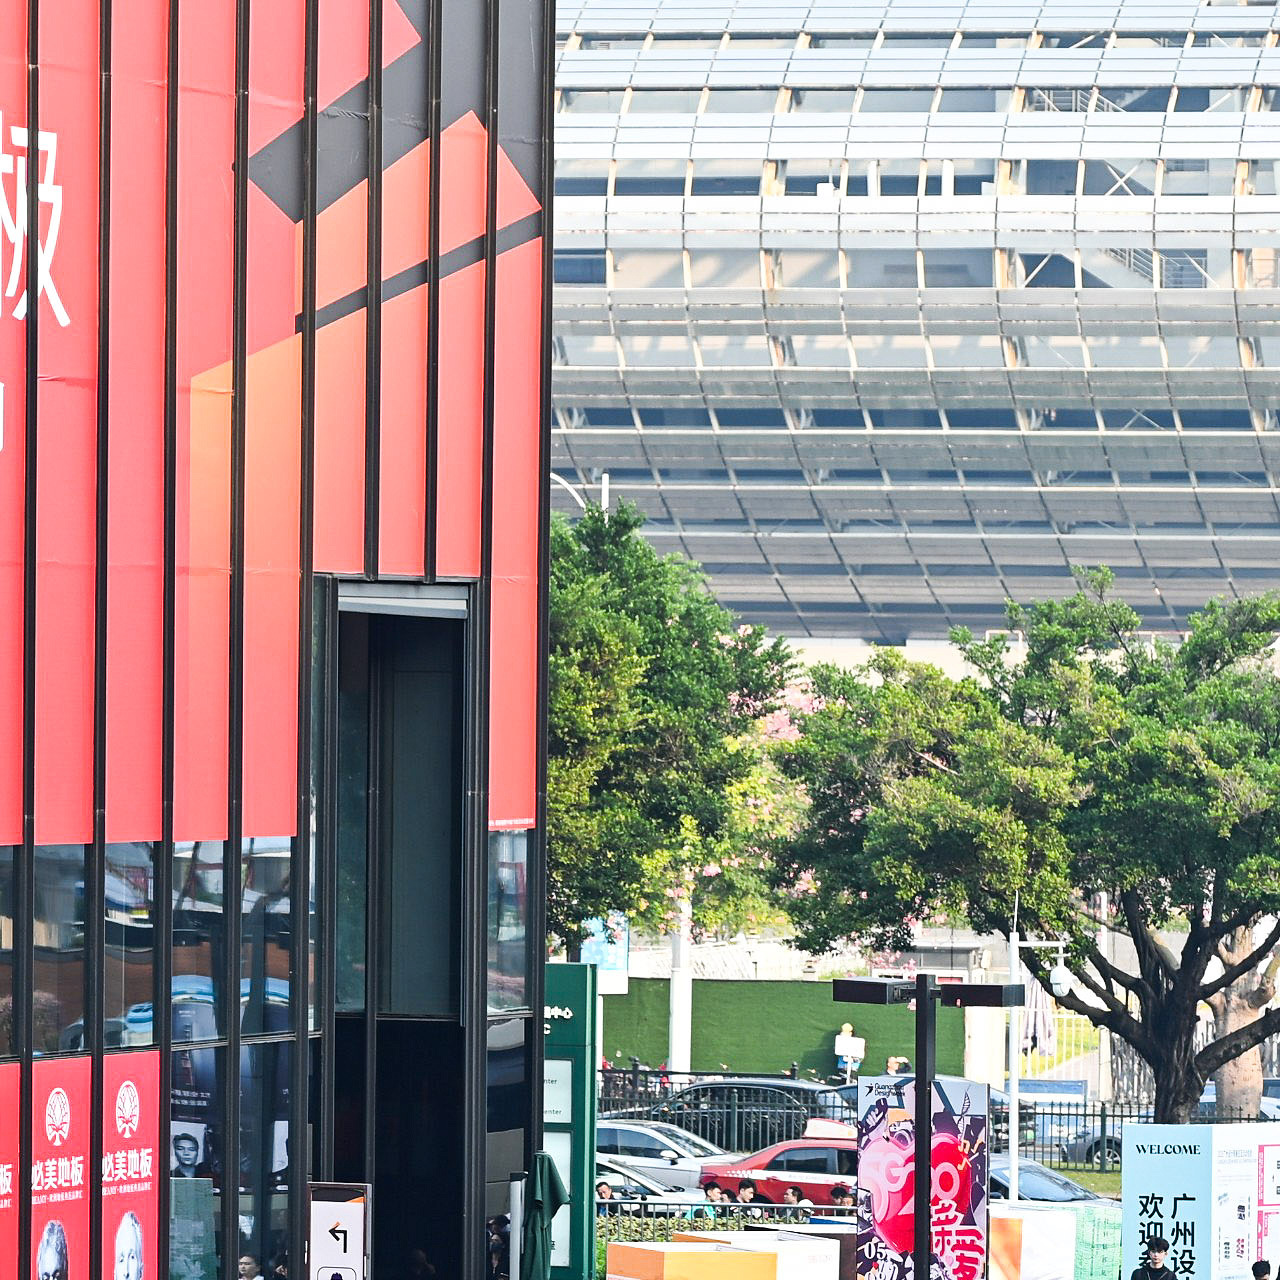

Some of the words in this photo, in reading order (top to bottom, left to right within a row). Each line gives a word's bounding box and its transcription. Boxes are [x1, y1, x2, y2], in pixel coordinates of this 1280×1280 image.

[1135, 1144, 1201, 1155] WELCOME
[31, 1156, 84, 1191] 必美地板
[102, 1148, 153, 1182] 必美地板
[864, 1242, 888, 1260] 05
